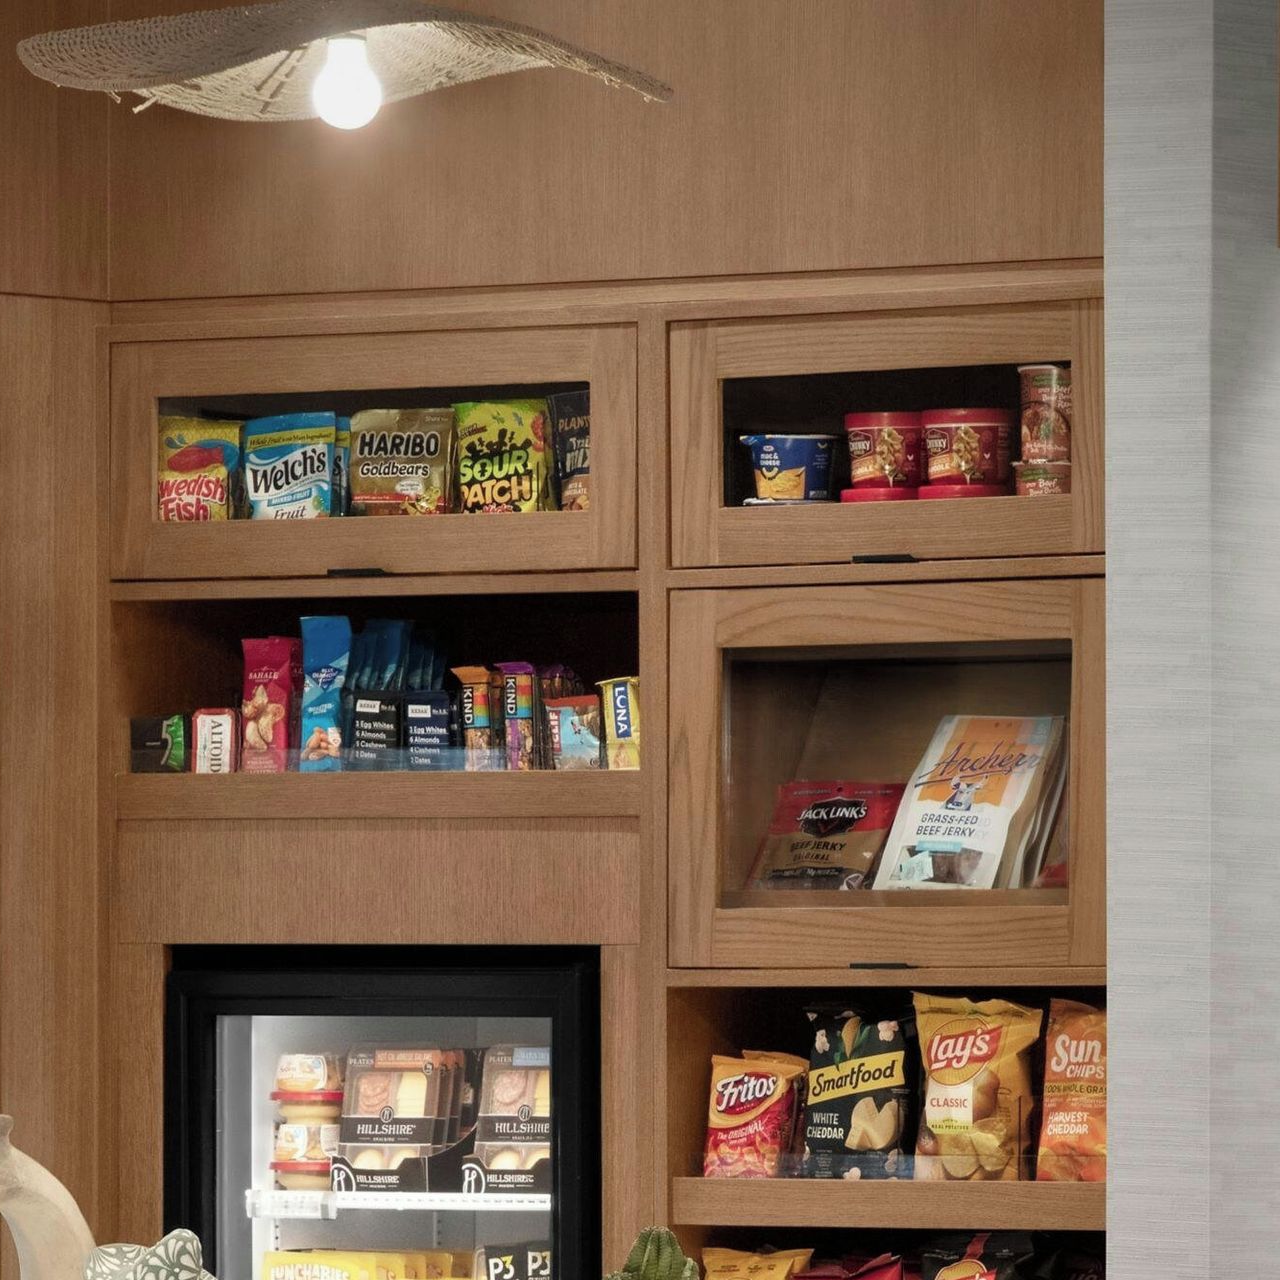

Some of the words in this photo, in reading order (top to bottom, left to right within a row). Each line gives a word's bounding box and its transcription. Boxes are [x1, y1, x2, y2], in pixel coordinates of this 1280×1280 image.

[559, 416, 590, 432] PLANT
[358, 432, 440, 458] HARIBO
[250, 448, 327, 496] Welch's
[360, 461, 430, 479] Goldbears
[460, 449, 530, 482] SOUR
[159, 474, 226, 503] wedish
[160, 499, 211, 520] Fish
[274, 504, 307, 519] Fruit
[248, 671, 279, 680] SAHALE
[507, 678, 517, 715] KIND
[464, 688, 474, 725] KIND
[614, 687, 628, 734] LUNA
[360, 721, 372, 729] Egg
[373, 721, 394, 729] Whites
[361, 731, 386, 739] Almonds
[415, 736, 440, 744] Almonds
[209, 719, 223, 774] ALTOID
[797, 805, 829, 821] JACK
[921, 813, 979, 826] GRASS-FED
[916, 825, 941, 836] BEEF
[941, 826, 976, 838] JERKY
[816, 840, 847, 851] JERKY
[931, 1028, 991, 1070] Lay's
[1051, 1034, 1102, 1072] Sun
[812, 1060, 897, 1097] Smartfood
[1066, 1065, 1105, 1079] CHIPS
[716, 1073, 778, 1112] Fritos
[1062, 1085, 1085, 1094] WHOLE
[1086, 1085, 1107, 1094] GRA
[930, 1097, 968, 1108] CLASSIC
[812, 1112, 839, 1125] WHITE
[1048, 1111, 1090, 1123] HARVEST
[357, 1124, 413, 1135] HILLSHIRE
[495, 1122, 550, 1134] HILLSHIRE
[728, 1119, 765, 1140] ORIGINAL
[806, 1126, 844, 1140] CHEDDAR
[1047, 1124, 1089, 1136] CHEDDAR
[356, 1175, 399, 1184] HILLSHIRE
[488, 1255, 515, 1280] P3
[527, 1251, 550, 1276] P3
